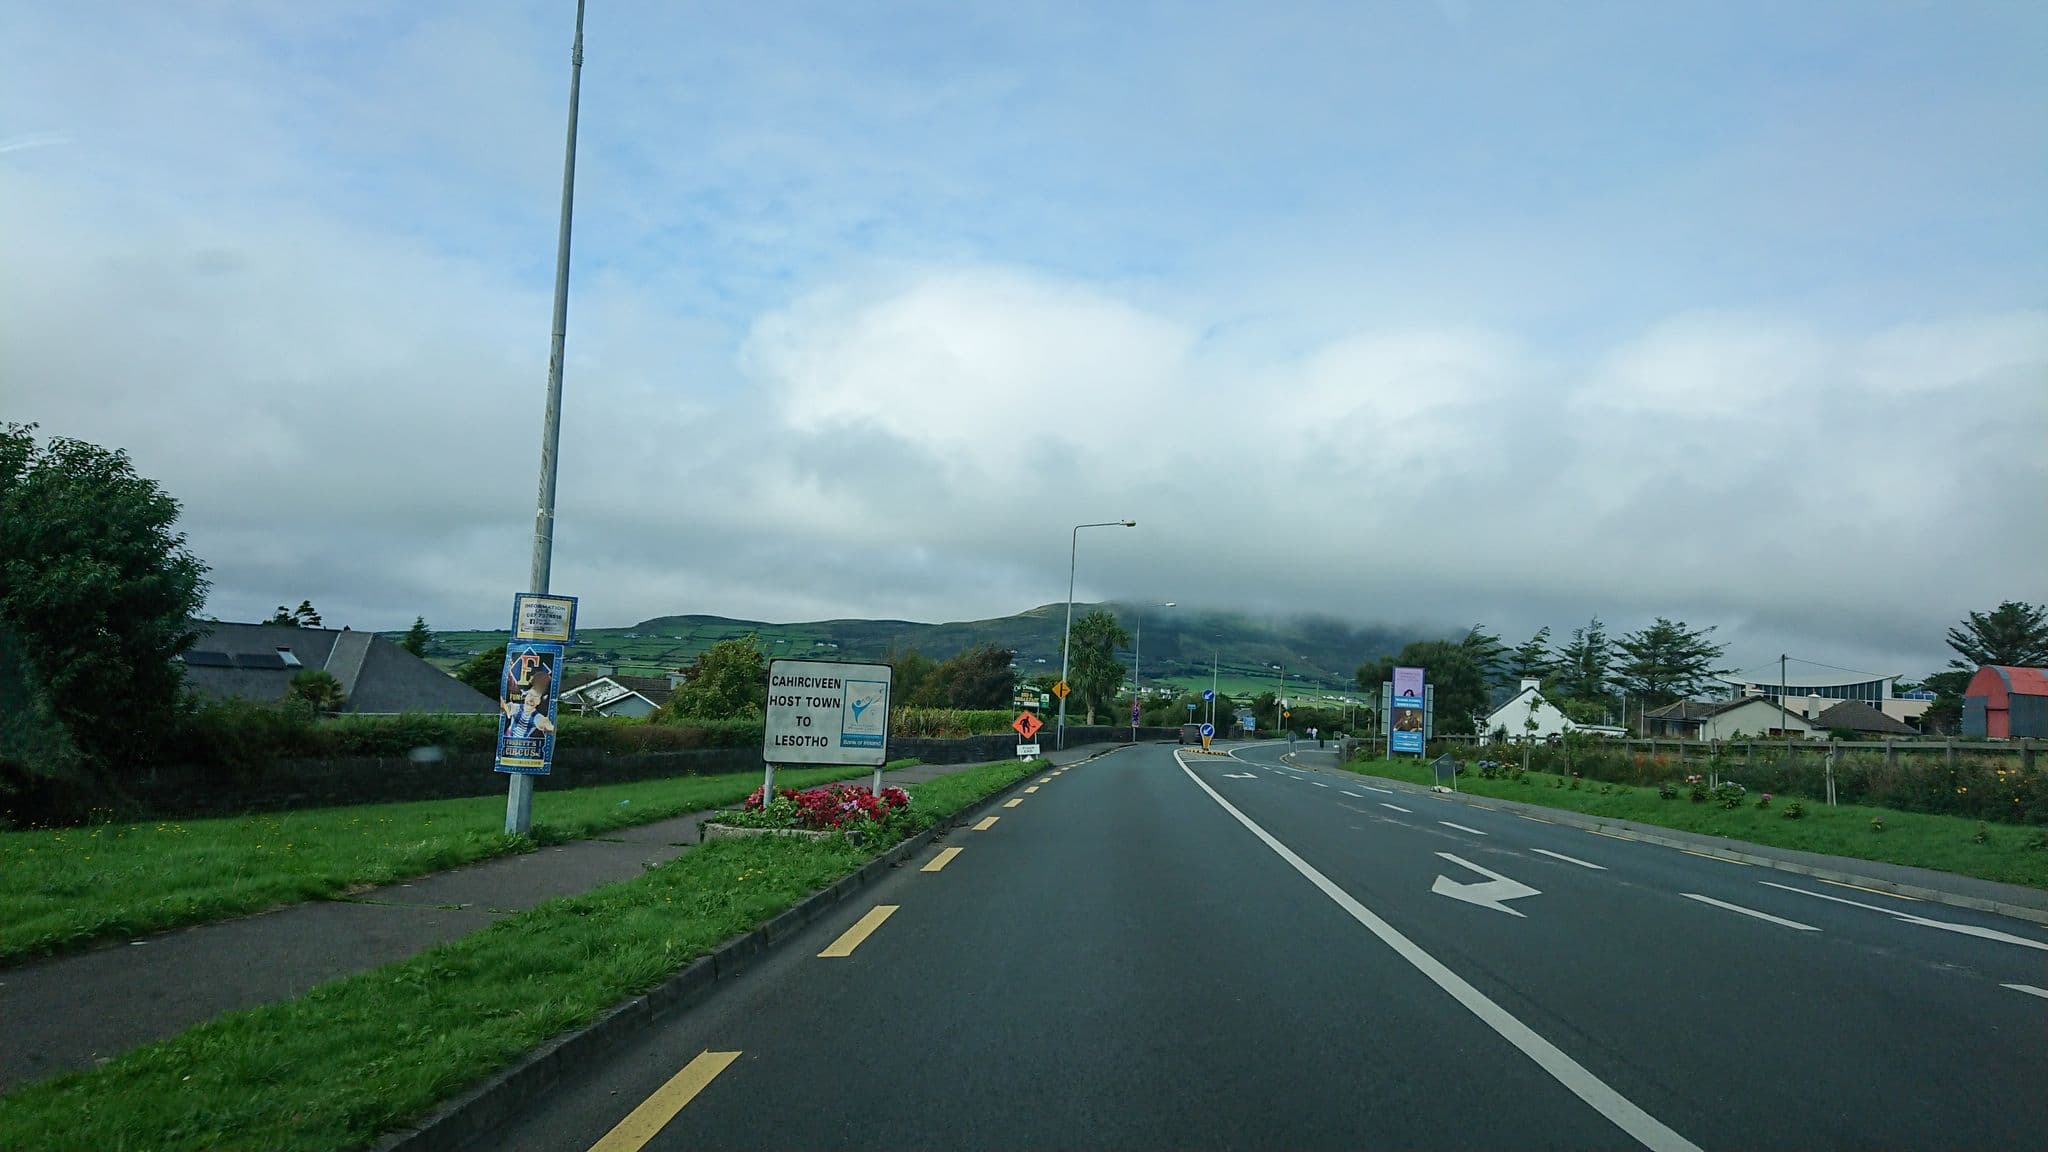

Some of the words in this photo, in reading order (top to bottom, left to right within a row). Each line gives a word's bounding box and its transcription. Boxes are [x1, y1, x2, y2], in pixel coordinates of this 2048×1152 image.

[525, 603, 566, 611] INFORMATION
[772, 676, 840, 689] CAHIRCIVEEN
[769, 695, 801, 707] HOST
[806, 697, 841, 708] TOWN
[795, 716, 811, 727] TO
[775, 735, 829, 747] LESOTHO
[505, 747, 537, 757] CIRCUS
